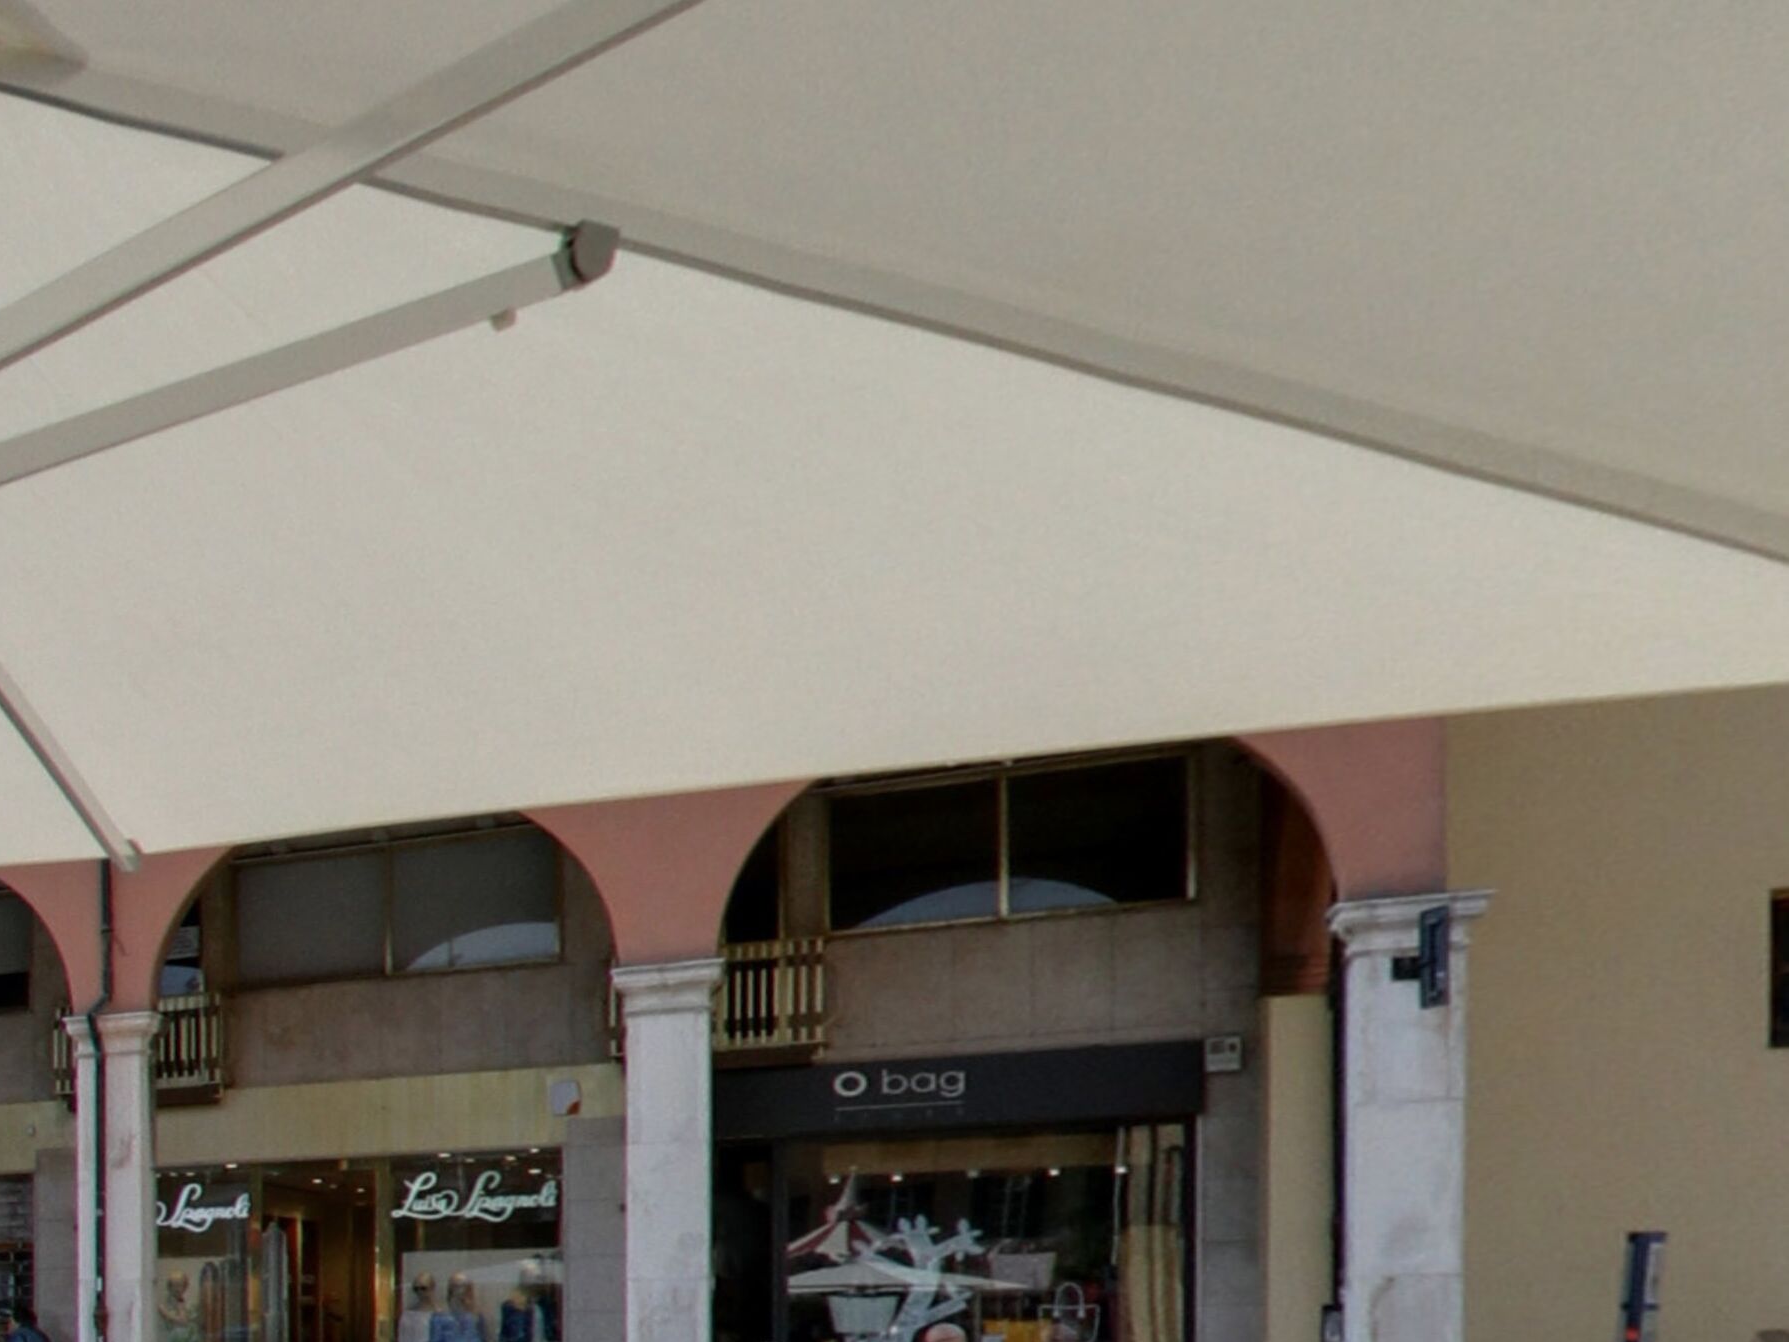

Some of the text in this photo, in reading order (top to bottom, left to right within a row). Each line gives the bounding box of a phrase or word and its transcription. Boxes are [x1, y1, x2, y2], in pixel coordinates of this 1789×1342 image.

[833, 1069, 965, 1097] O bag
[169, 1183, 250, 1232] Spagnoli
[463, 1170, 556, 1222] Spagnoli
